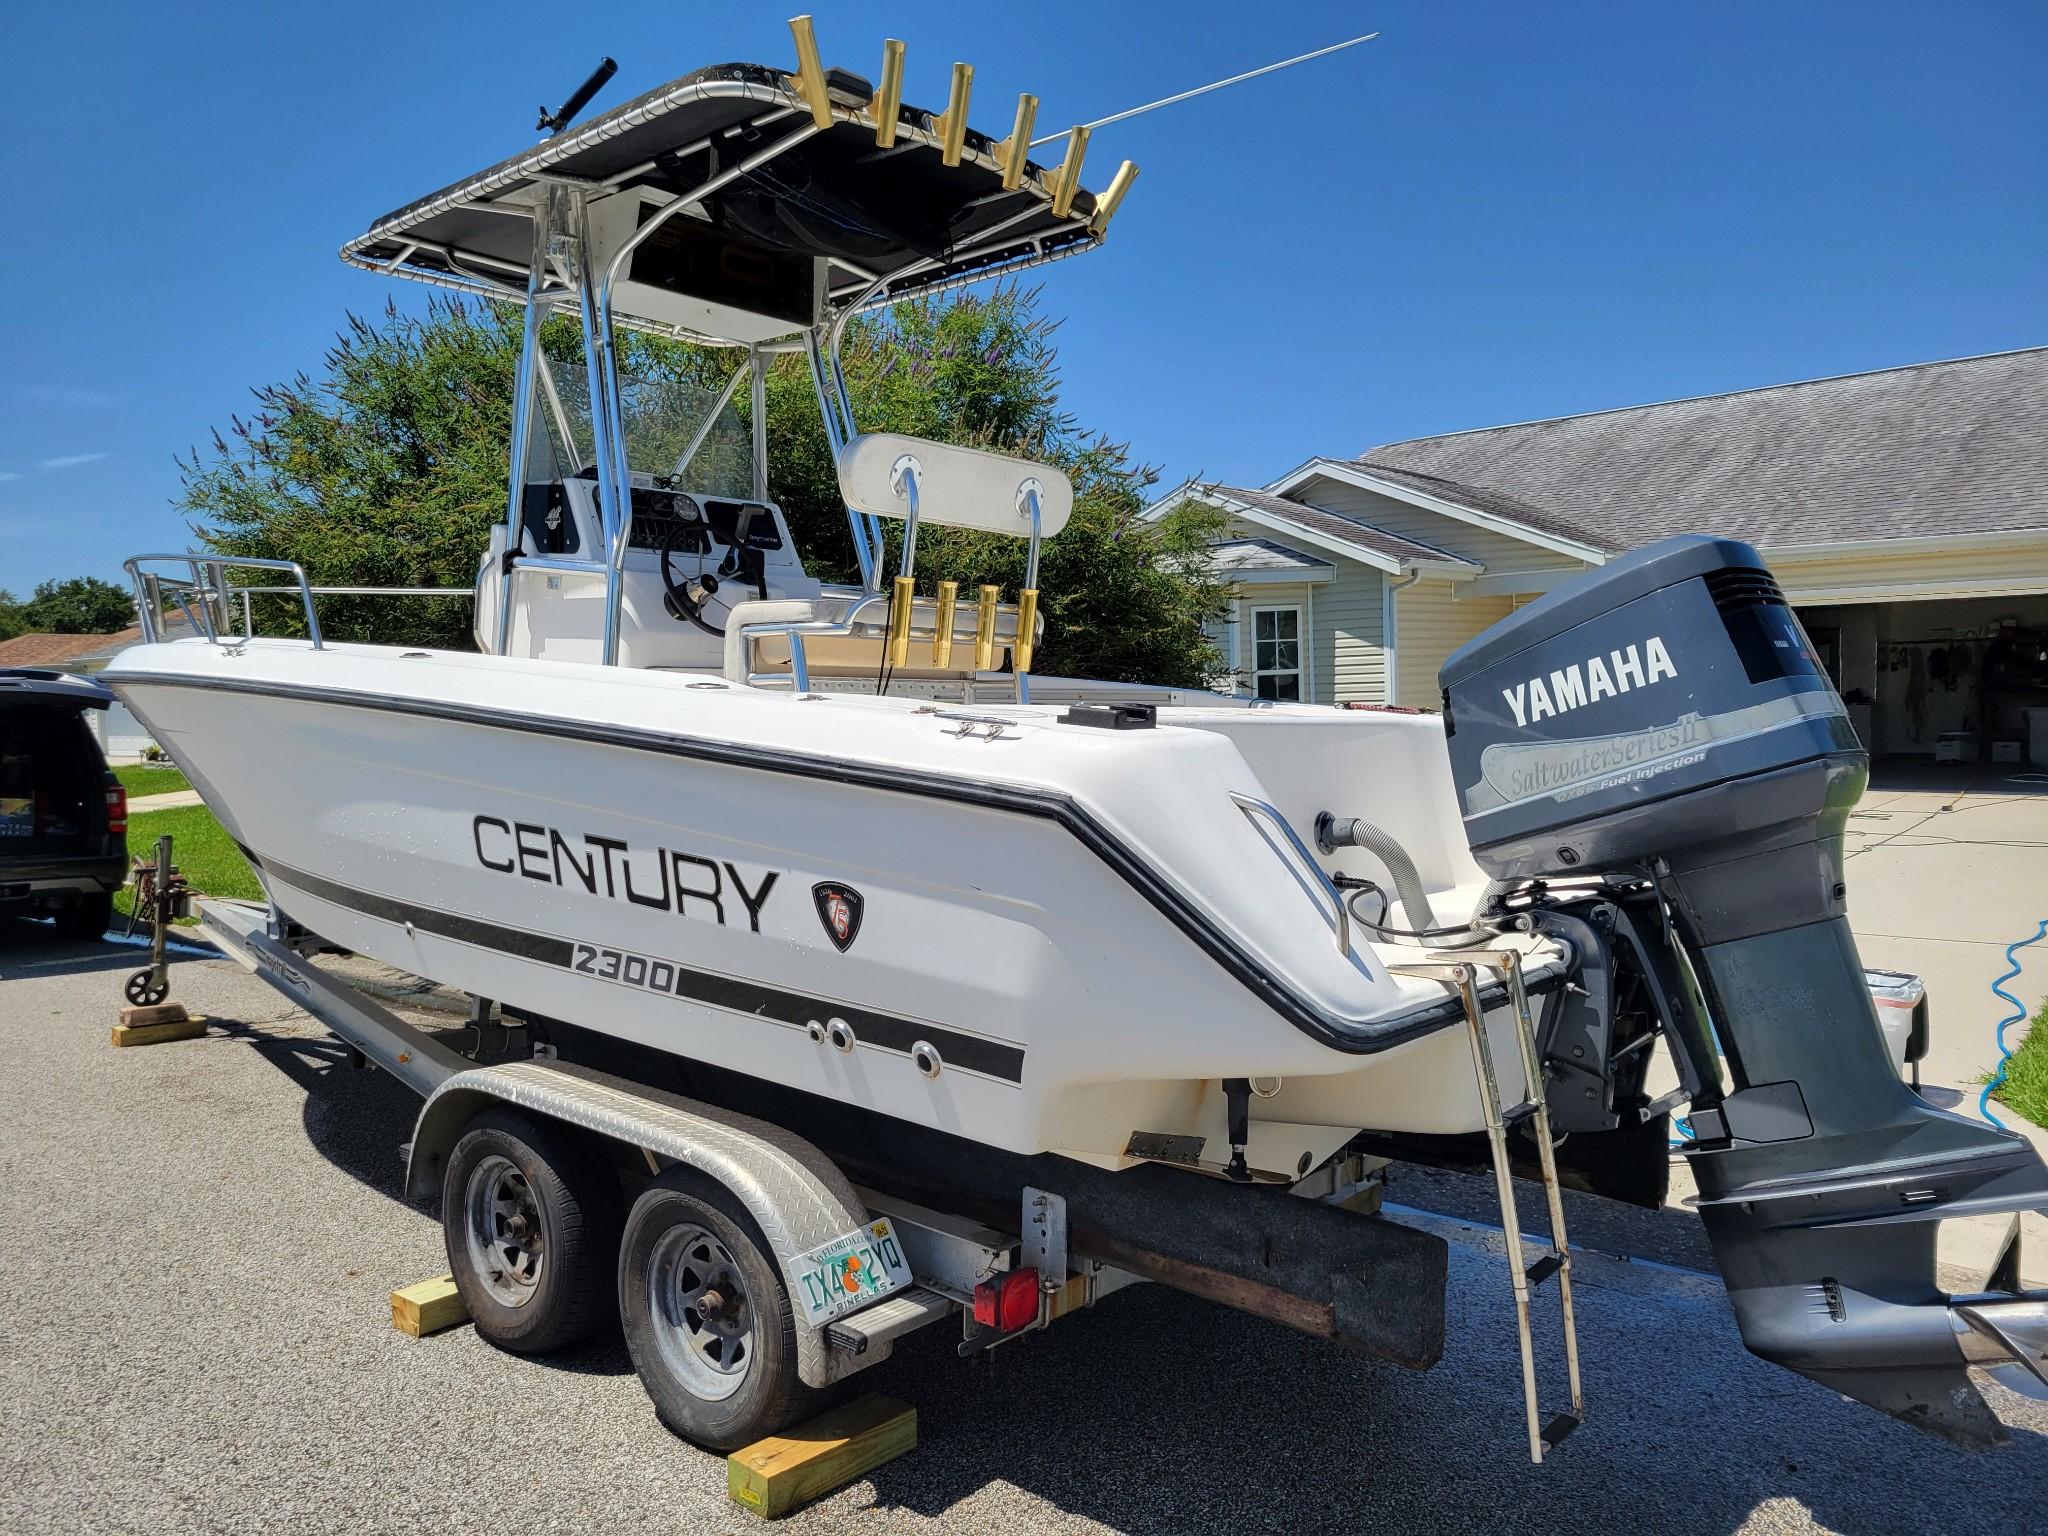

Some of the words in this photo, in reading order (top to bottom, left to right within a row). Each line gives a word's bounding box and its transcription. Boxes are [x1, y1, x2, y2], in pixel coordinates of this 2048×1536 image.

[1502, 636, 1678, 728] YAMAHA
[1600, 772, 1632, 790] Fuel
[1636, 752, 1705, 780] Injection
[473, 814, 781, 935] CENTURY
[575, 944, 674, 993] 2300
